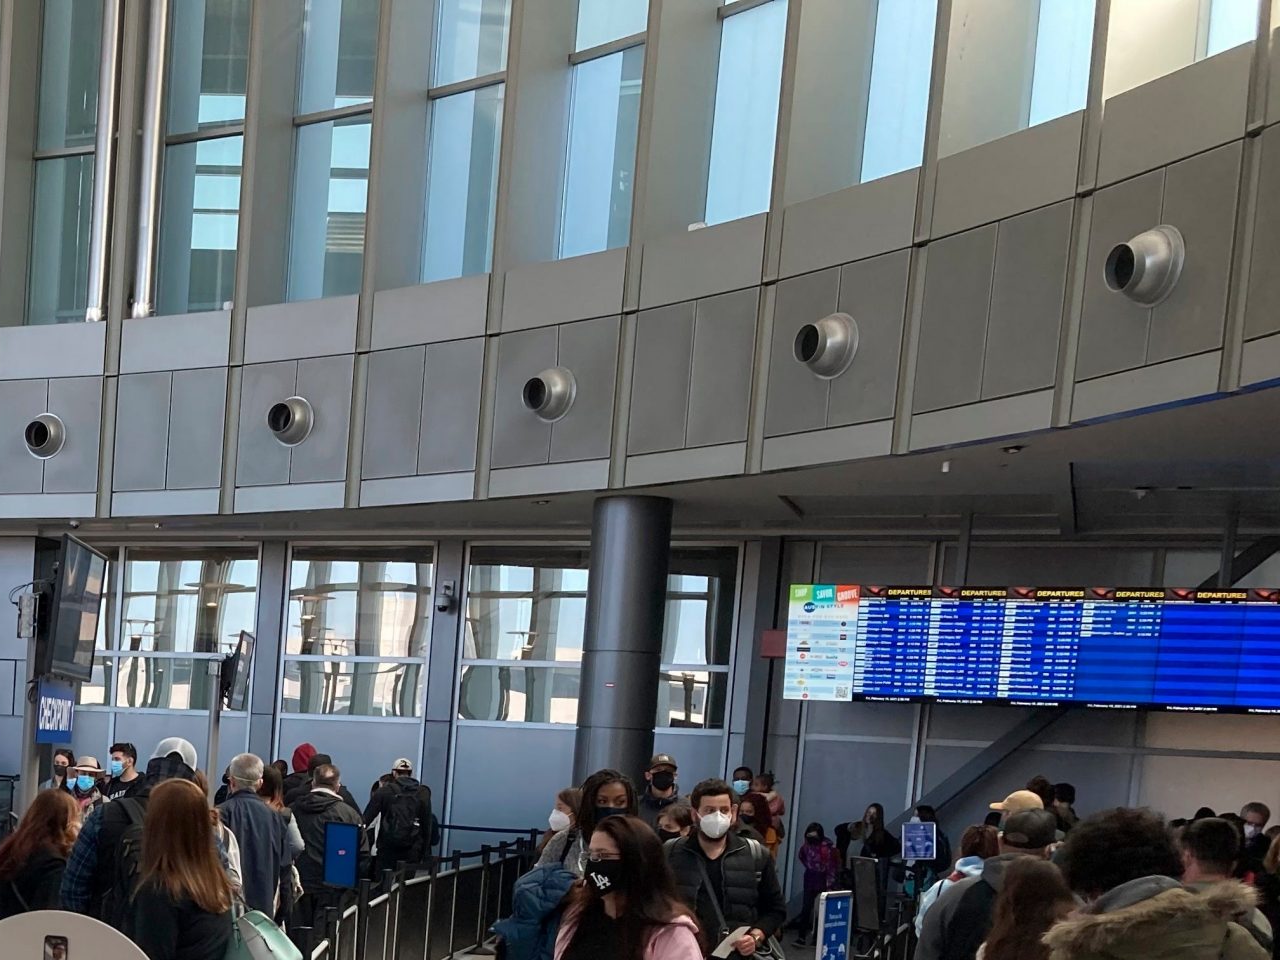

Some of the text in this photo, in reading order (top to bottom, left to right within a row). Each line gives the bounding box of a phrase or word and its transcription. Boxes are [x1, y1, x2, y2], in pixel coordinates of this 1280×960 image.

[888, 588, 932, 596] DEPARTURES
[961, 589, 1007, 597] DEPARTURES
[1037, 590, 1085, 598] DEPARTURES
[590, 872, 611, 889] LA
